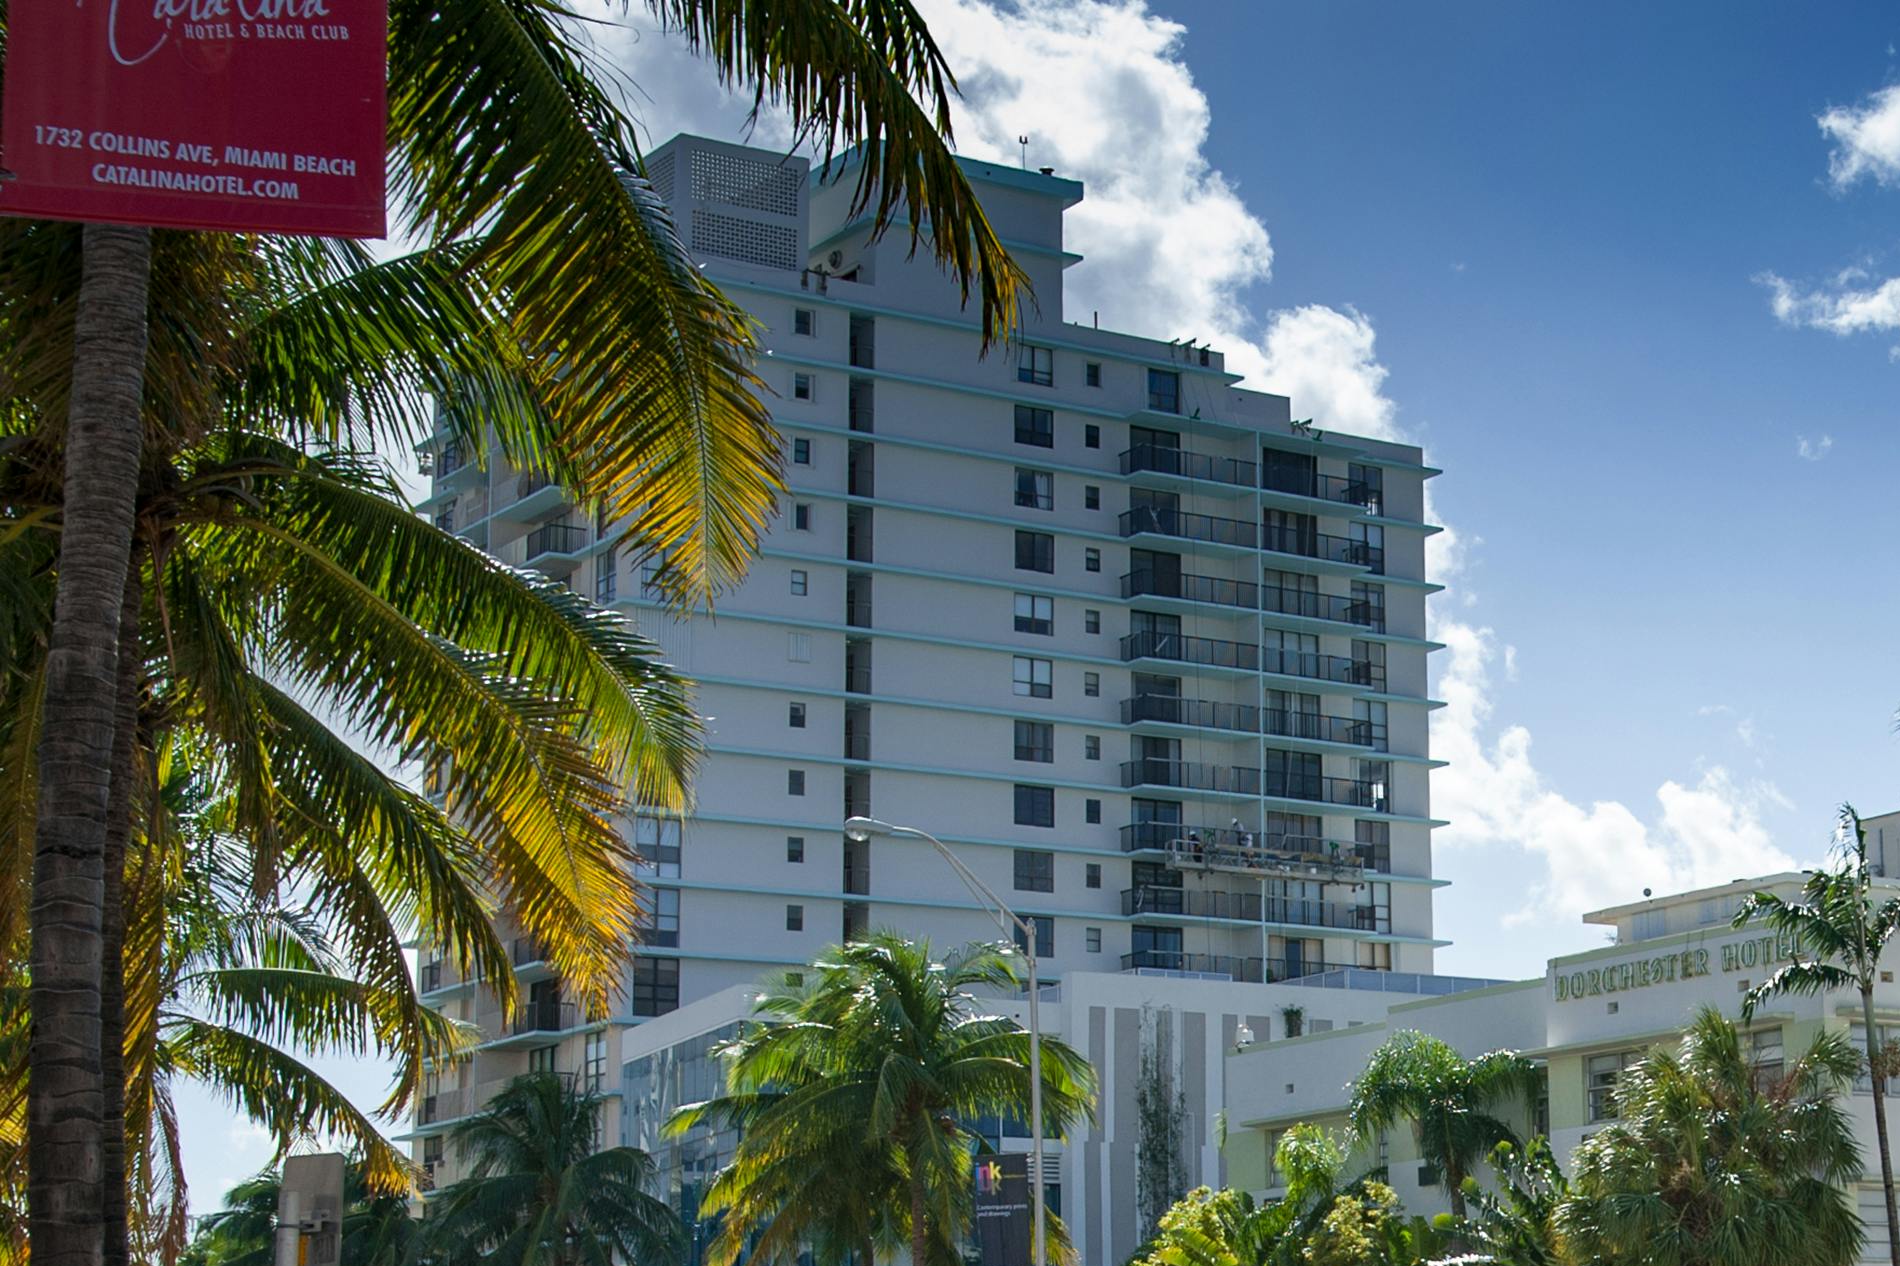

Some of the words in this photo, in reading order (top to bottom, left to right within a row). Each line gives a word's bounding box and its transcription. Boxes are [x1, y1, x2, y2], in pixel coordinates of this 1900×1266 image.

[107, 0, 331, 65] Caana
[184, 23, 234, 39] HOTEL
[239, 24, 251, 39] &
[256, 24, 305, 40] BEACH
[311, 25, 350, 40] CLUB
[34, 125, 83, 149] 1732
[89, 131, 171, 159] COLLINS
[175, 143, 219, 168] AVE,
[224, 146, 288, 171] MIAMI
[294, 155, 357, 177] BEACH
[92, 164, 299, 200] CATALINAHOTEL.COM
[1555, 948, 1712, 1002] DORCHESTER
[1721, 932, 1809, 973] HOTEL
